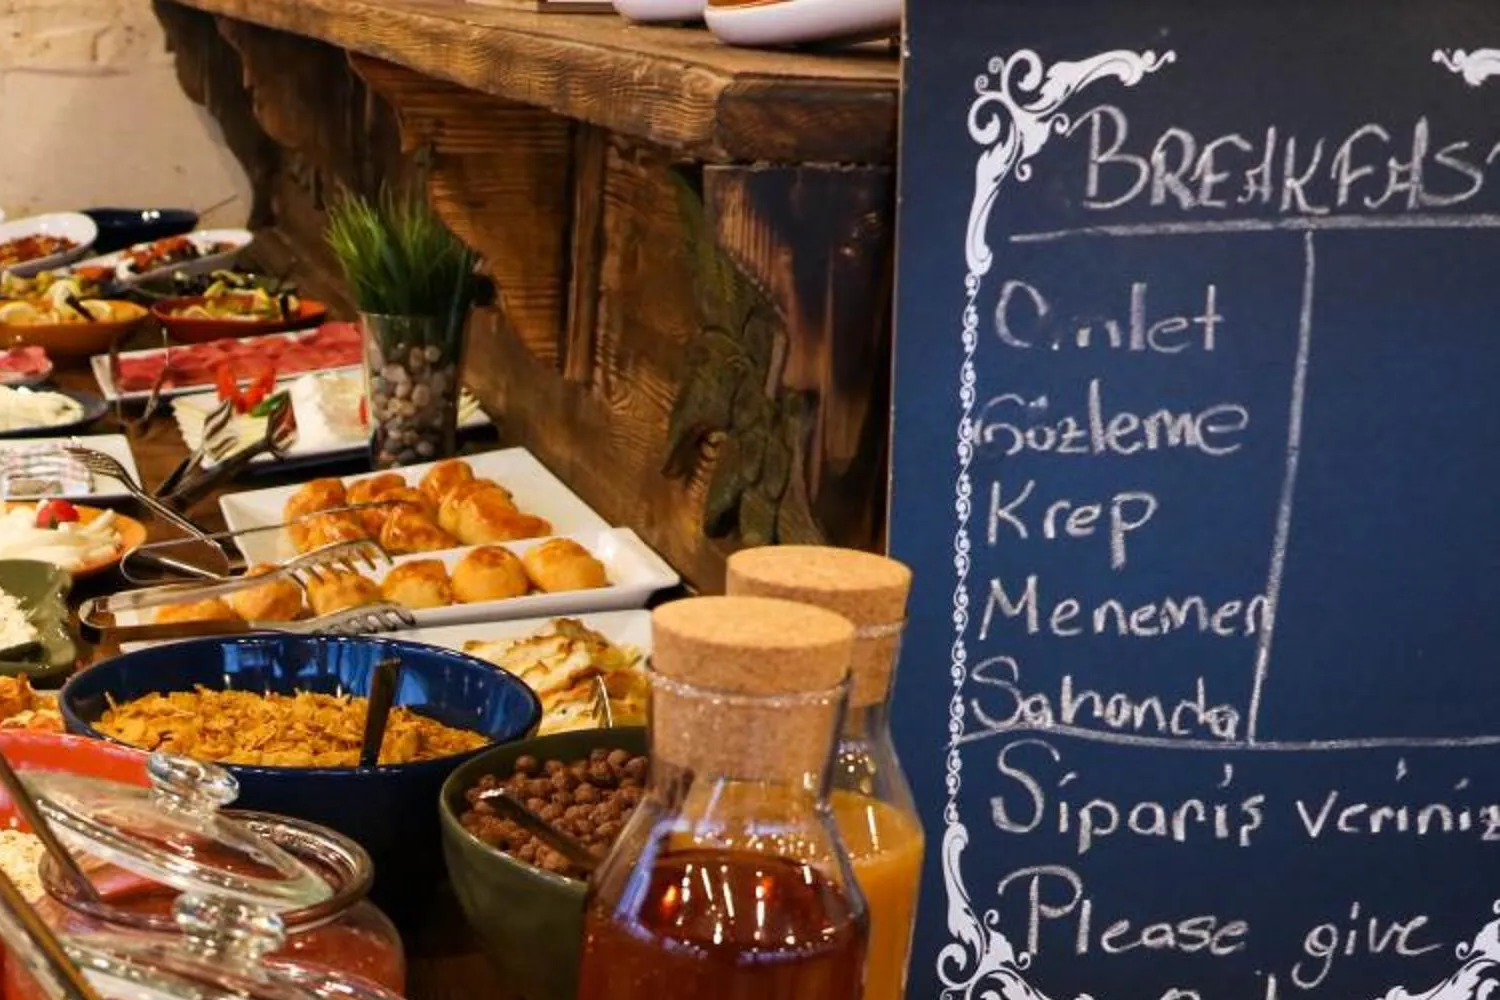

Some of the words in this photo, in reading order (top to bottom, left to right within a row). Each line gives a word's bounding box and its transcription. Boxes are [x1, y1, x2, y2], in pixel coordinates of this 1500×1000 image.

[1066, 105, 1500, 214] BREAKFAS
[987, 480, 1158, 570] Krep
[978, 574, 1272, 641] Menemen
[971, 655, 1239, 740] Sahanda
[996, 865, 1249, 956] Please
[1291, 902, 1444, 990] give
